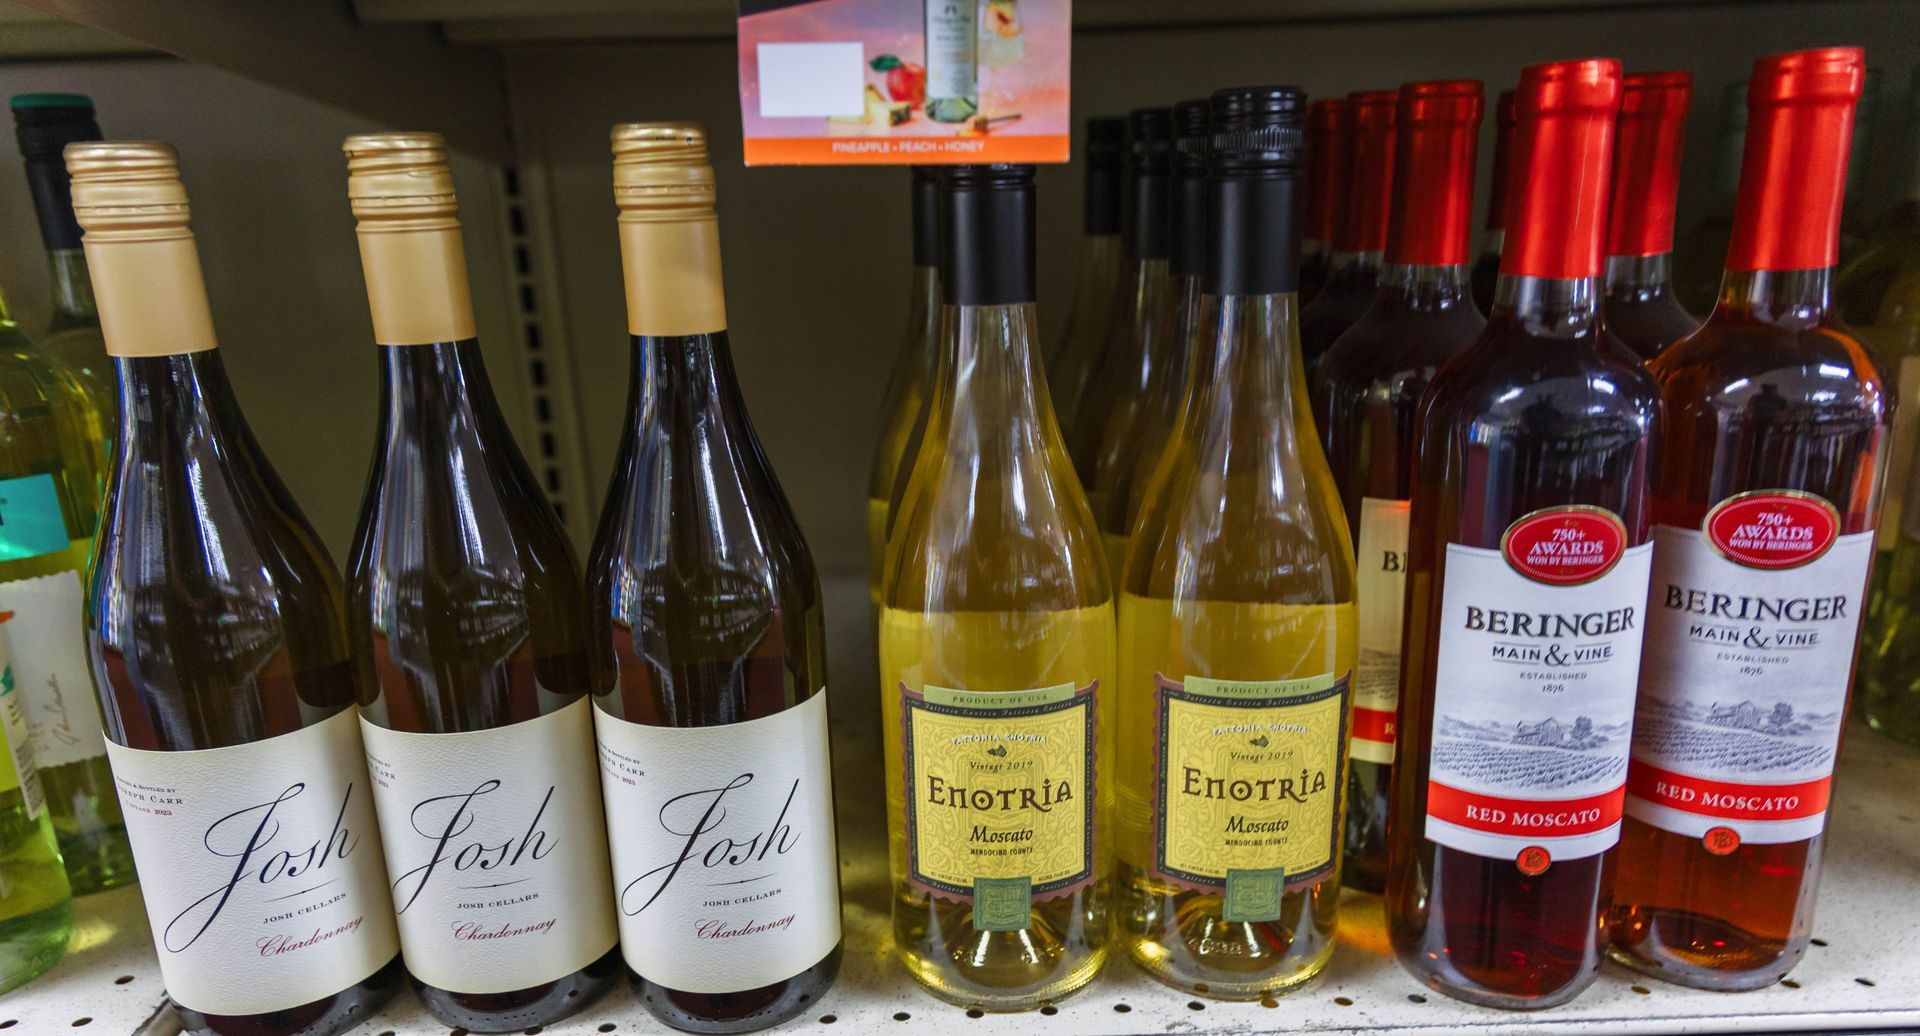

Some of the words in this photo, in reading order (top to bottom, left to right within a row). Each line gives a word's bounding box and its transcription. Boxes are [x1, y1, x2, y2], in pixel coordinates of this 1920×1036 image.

[831, 141, 890, 153] PINEAPPLE
[899, 141, 937, 153] PEACH
[944, 140, 985, 153] HONEY
[1757, 512, 1793, 527] 750+
[1551, 528, 1586, 542] 750+
[1732, 525, 1814, 540] AWARDS
[1530, 540, 1604, 555] AWARDS
[1728, 538, 1751, 549] WON
[1751, 540, 1765, 550] BY
[1765, 539, 1813, 551] BERINGER
[1527, 555, 1548, 565] WON
[1549, 556, 1560, 566] BY
[1561, 554, 1604, 566] BERINGER
[1664, 585, 1848, 623] BERINGER
[1464, 606, 1635, 638] BERINGER
[1689, 626, 1739, 643] MAIN
[1743, 626, 1773, 649] &
[1776, 631, 1819, 646] VINE
[1492, 645, 1541, 660] MAIN
[1544, 643, 1571, 667] &
[1574, 644, 1614, 661] VINE
[1716, 652, 1789, 665] ESTABLISHED
[1520, 671, 1587, 680] ESTABLISHED
[1739, 665, 1763, 676] 1876
[1216, 685, 1269, 694] PRODUCT
[1542, 684, 1565, 693] 1876
[952, 696, 1003, 704] PRODUCT
[1028, 693, 1047, 702] USA
[1230, 751, 1264, 764] Vintage
[620, 763, 645, 777] CARR
[970, 761, 1003, 774] Vintage
[1007, 760, 1034, 770] 2019
[150, 795, 183, 805] CARR
[1656, 781, 1696, 802] RED
[1701, 792, 1799, 812] MOSCATO
[154, 808, 172, 816] 2023
[1466, 804, 1506, 824] RED
[1511, 807, 1600, 827] MOSCATO
[1225, 815, 1290, 834] Moscato
[969, 825, 1033, 844] Moscato
[392, 779, 559, 915] Josh
[621, 773, 802, 917] Josh
[970, 847, 1007, 856] MENDOCINO
[1009, 846, 1033, 856] COUNTY
[163, 782, 360, 954] Josh
[488, 892, 539, 909] CELLARS
[734, 888, 782, 905] CELLARS
[263, 912, 293, 924] JOSH
[297, 892, 347, 915] CELLARS
[451, 918, 556, 941] Chardonnay
[694, 913, 796, 940] Chardonnay
[255, 914, 364, 957] Chardonnay
